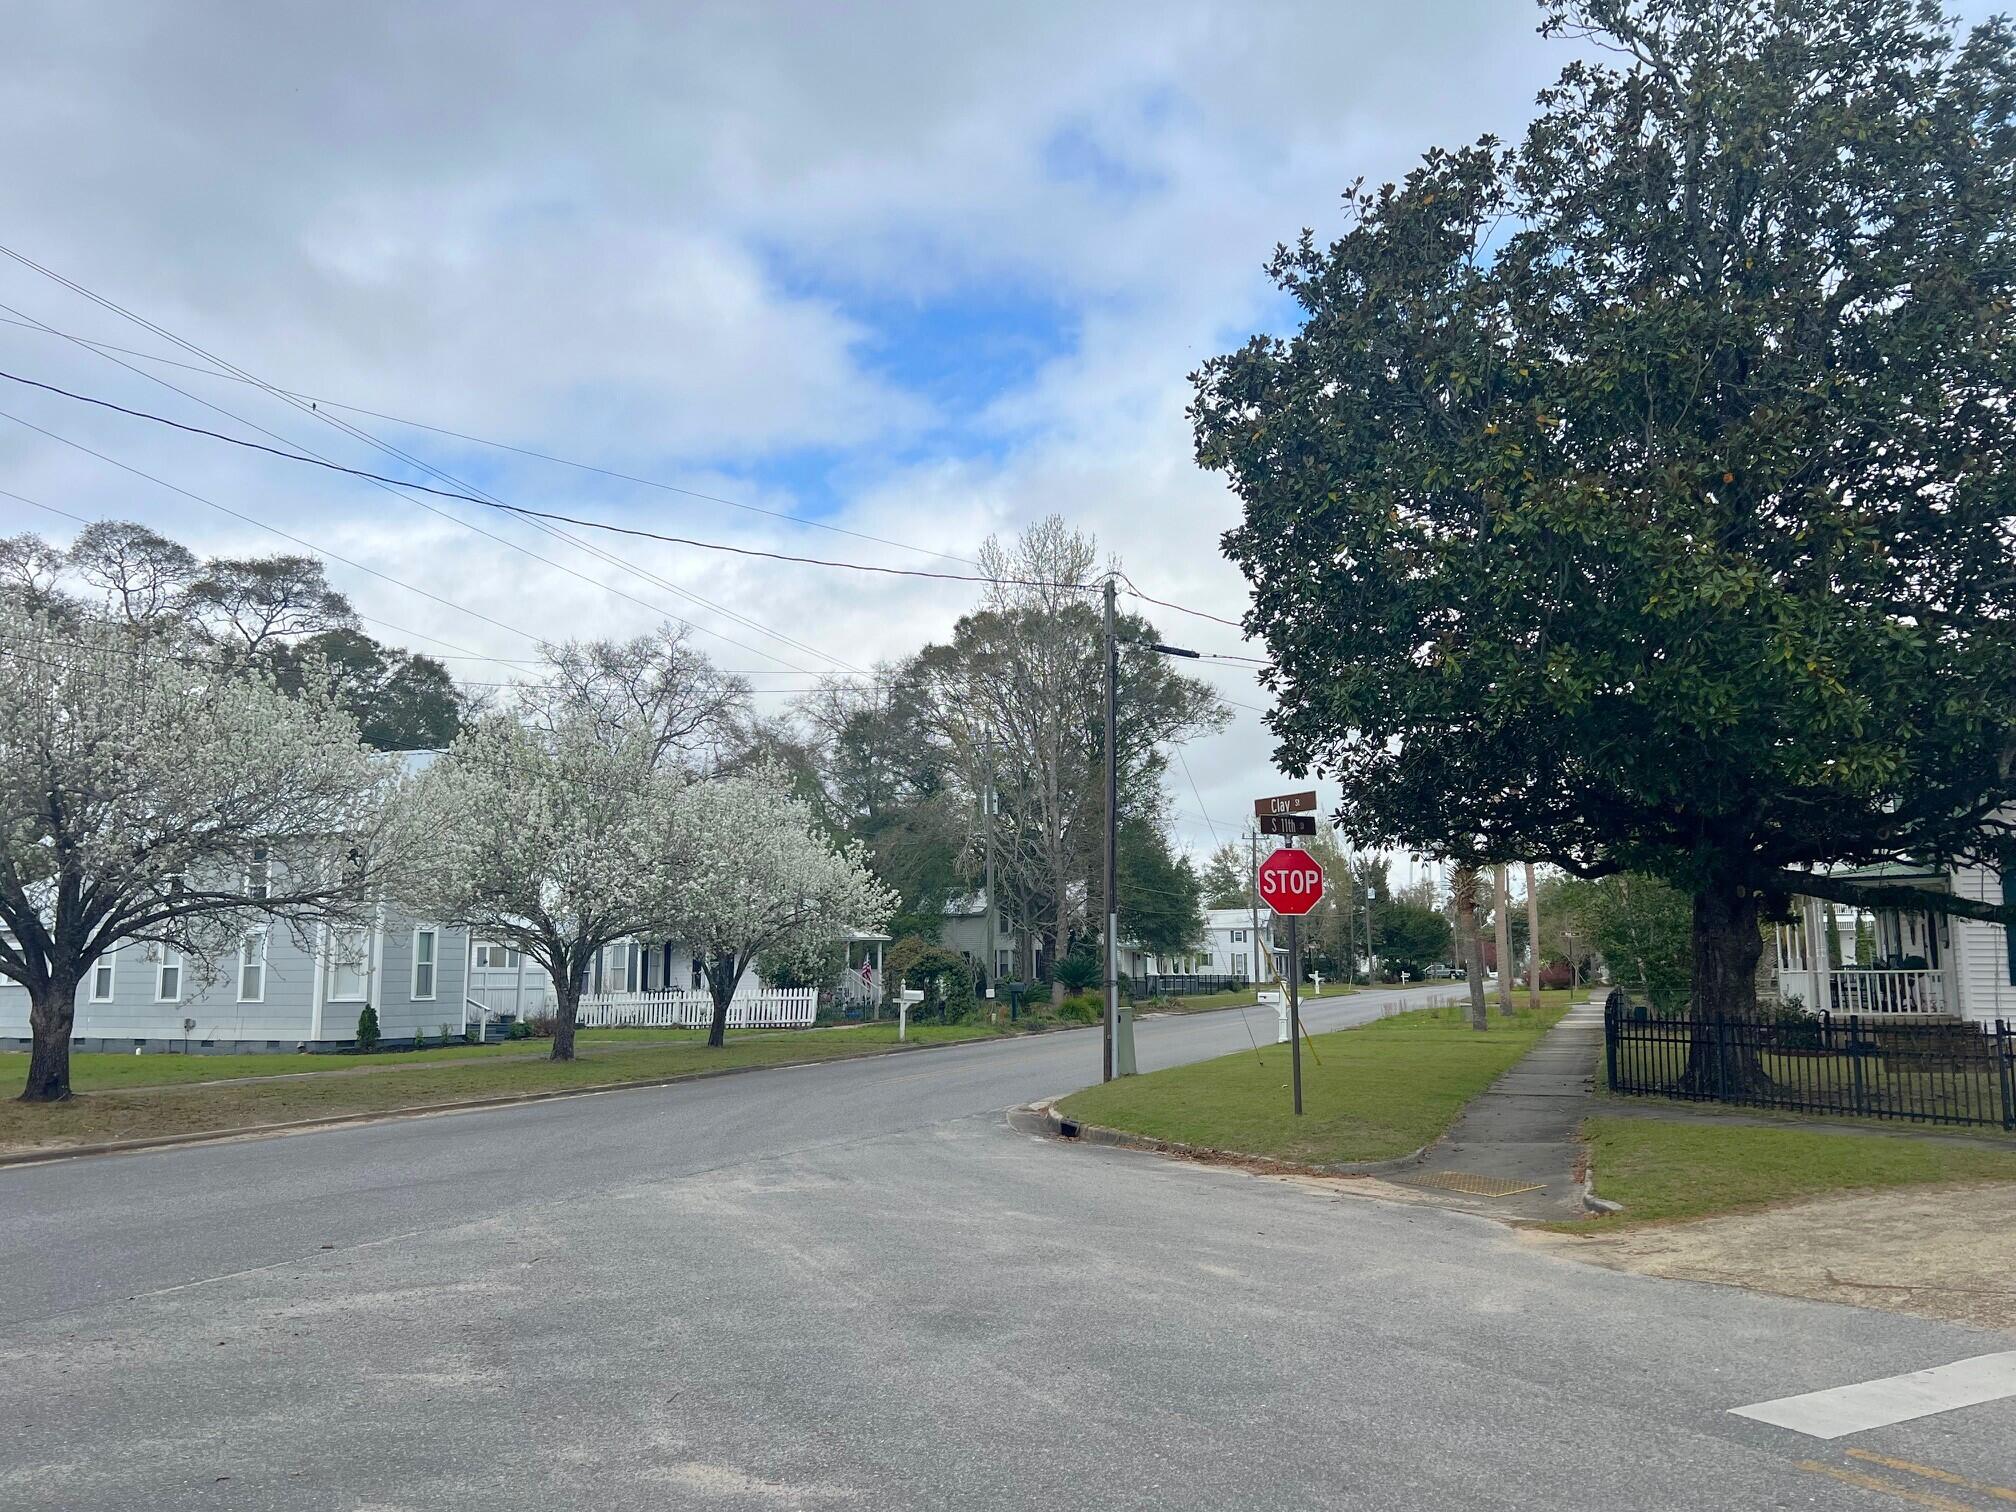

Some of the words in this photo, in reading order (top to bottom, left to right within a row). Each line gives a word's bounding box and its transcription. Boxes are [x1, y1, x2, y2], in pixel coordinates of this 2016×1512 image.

[1271, 798, 1290, 813] Clay
[1271, 817, 1277, 833] S
[1281, 818, 1296, 832] 11th
[1263, 869, 1319, 894] STOP
